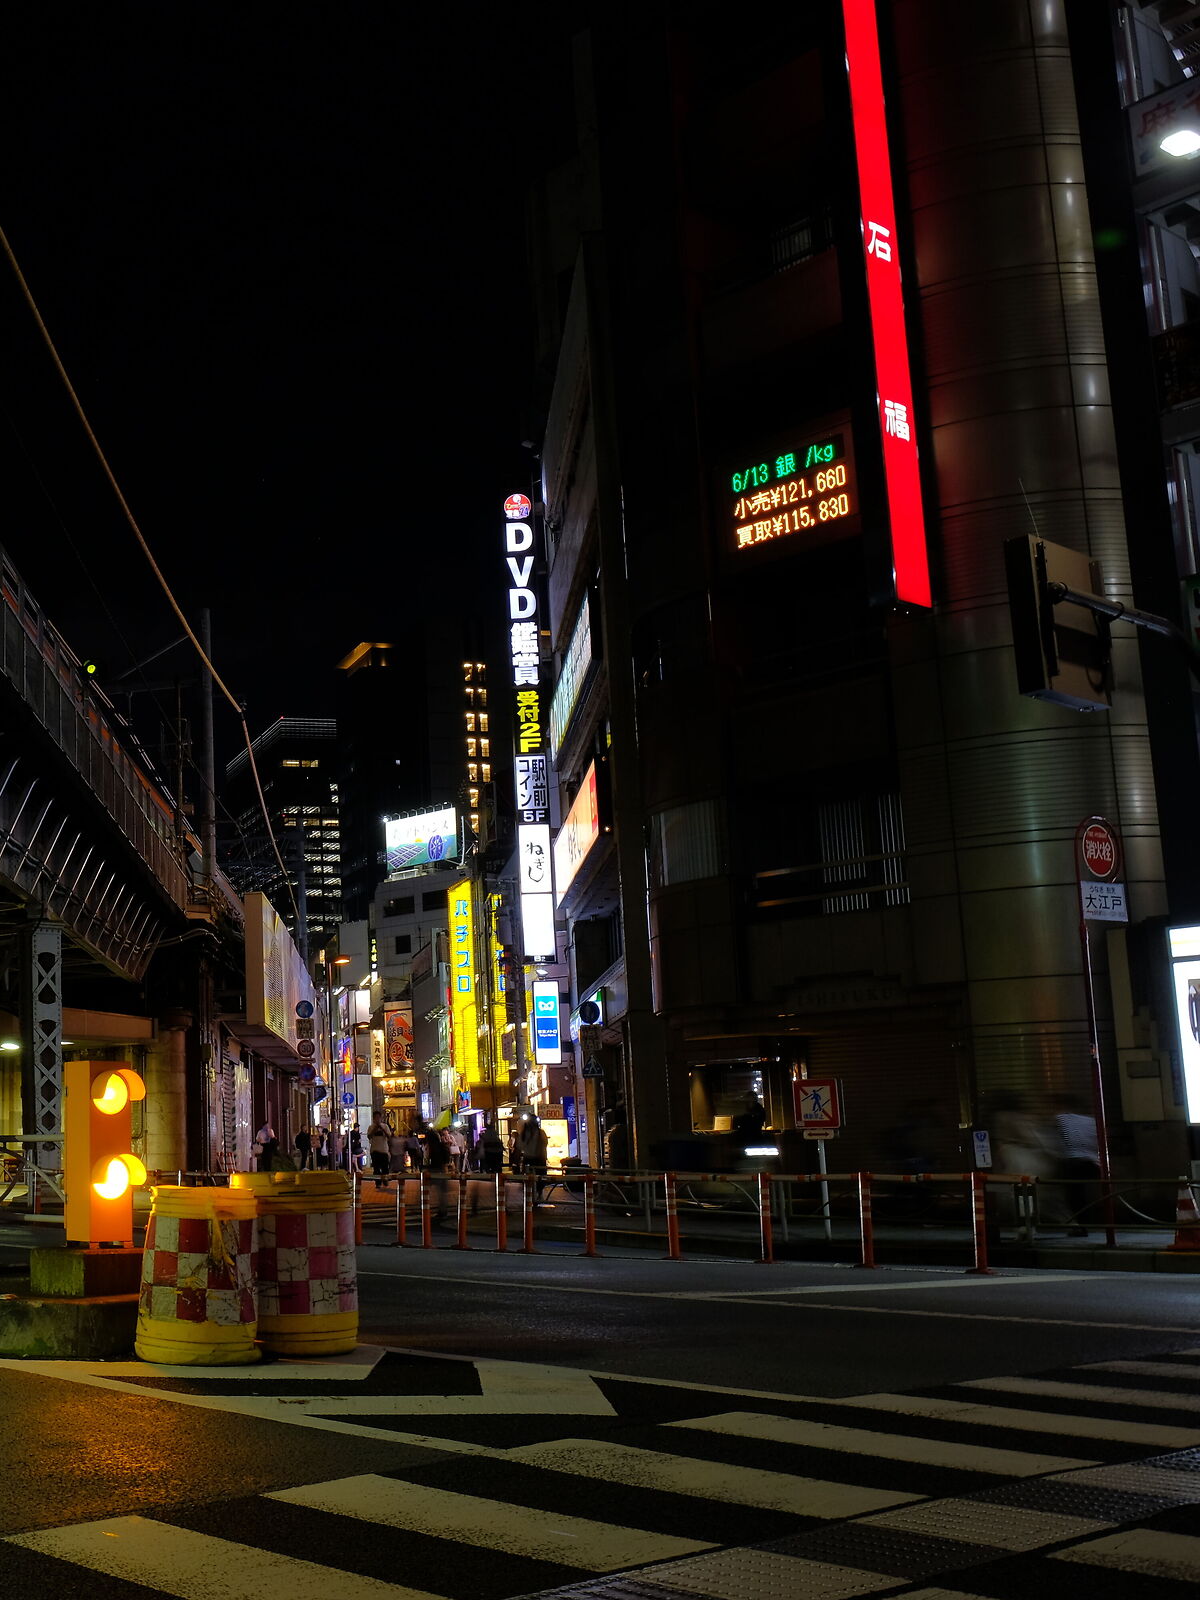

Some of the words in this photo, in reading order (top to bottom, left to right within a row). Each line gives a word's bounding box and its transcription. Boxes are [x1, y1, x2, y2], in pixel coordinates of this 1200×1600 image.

[732, 463, 769, 493] 6/13
[775, 453, 796, 478] 銀
[805, 444, 834, 468] /kg
[505, 522, 540, 686] DVD鑑賞
[516, 690, 542, 753] 受付2F
[518, 759, 533, 807] コイン
[531, 759, 547, 807] 駅前
[523, 810, 545, 822] 5F
[526, 841, 544, 883] ねぎし
[1086, 840, 1112, 861] 消火栓
[1085, 894, 1122, 910] 大江戸
[455, 900, 471, 992] パチスロ
[301, 1045, 311, 1053] 30
